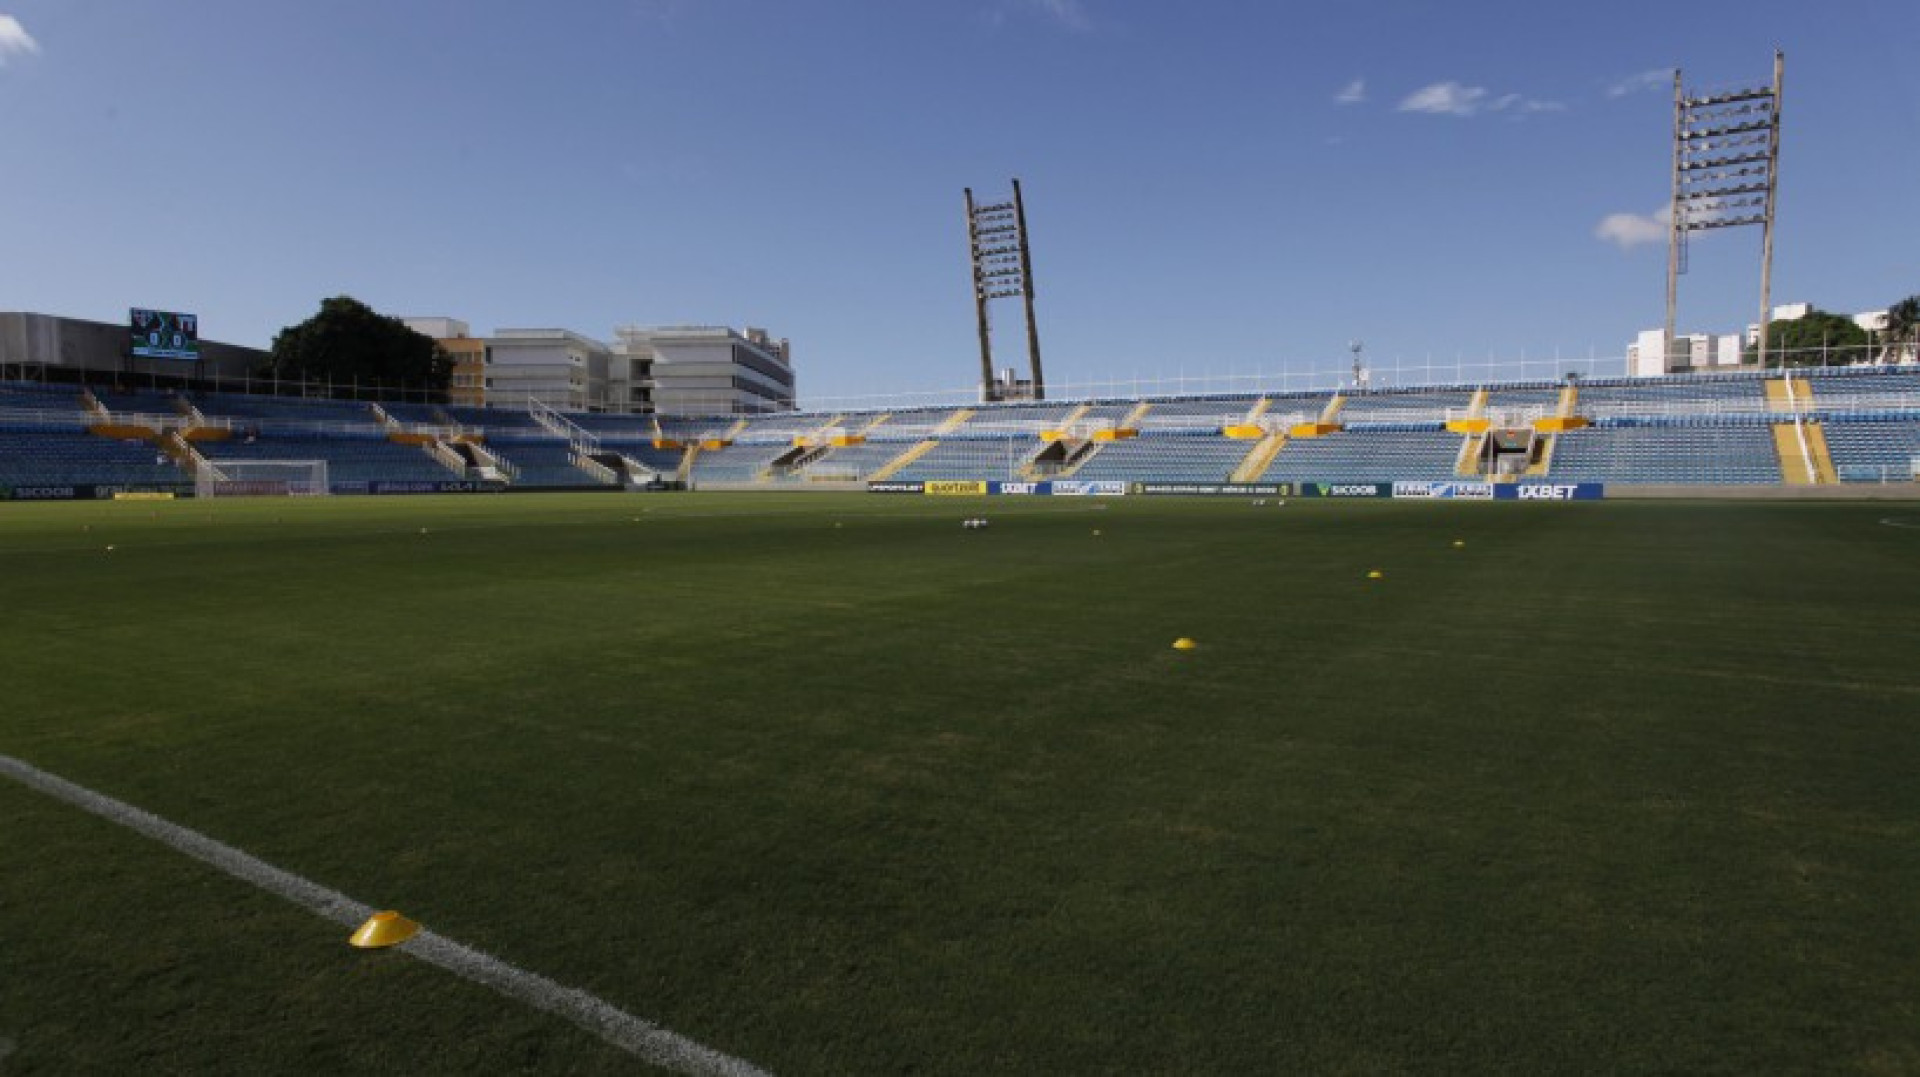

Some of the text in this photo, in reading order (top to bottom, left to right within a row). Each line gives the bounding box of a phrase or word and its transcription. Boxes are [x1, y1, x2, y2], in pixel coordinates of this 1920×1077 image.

[15, 487, 74, 497] SICOOB
[1331, 484, 1377, 495] SICOOB
[1516, 485, 1578, 499] 1XBET
